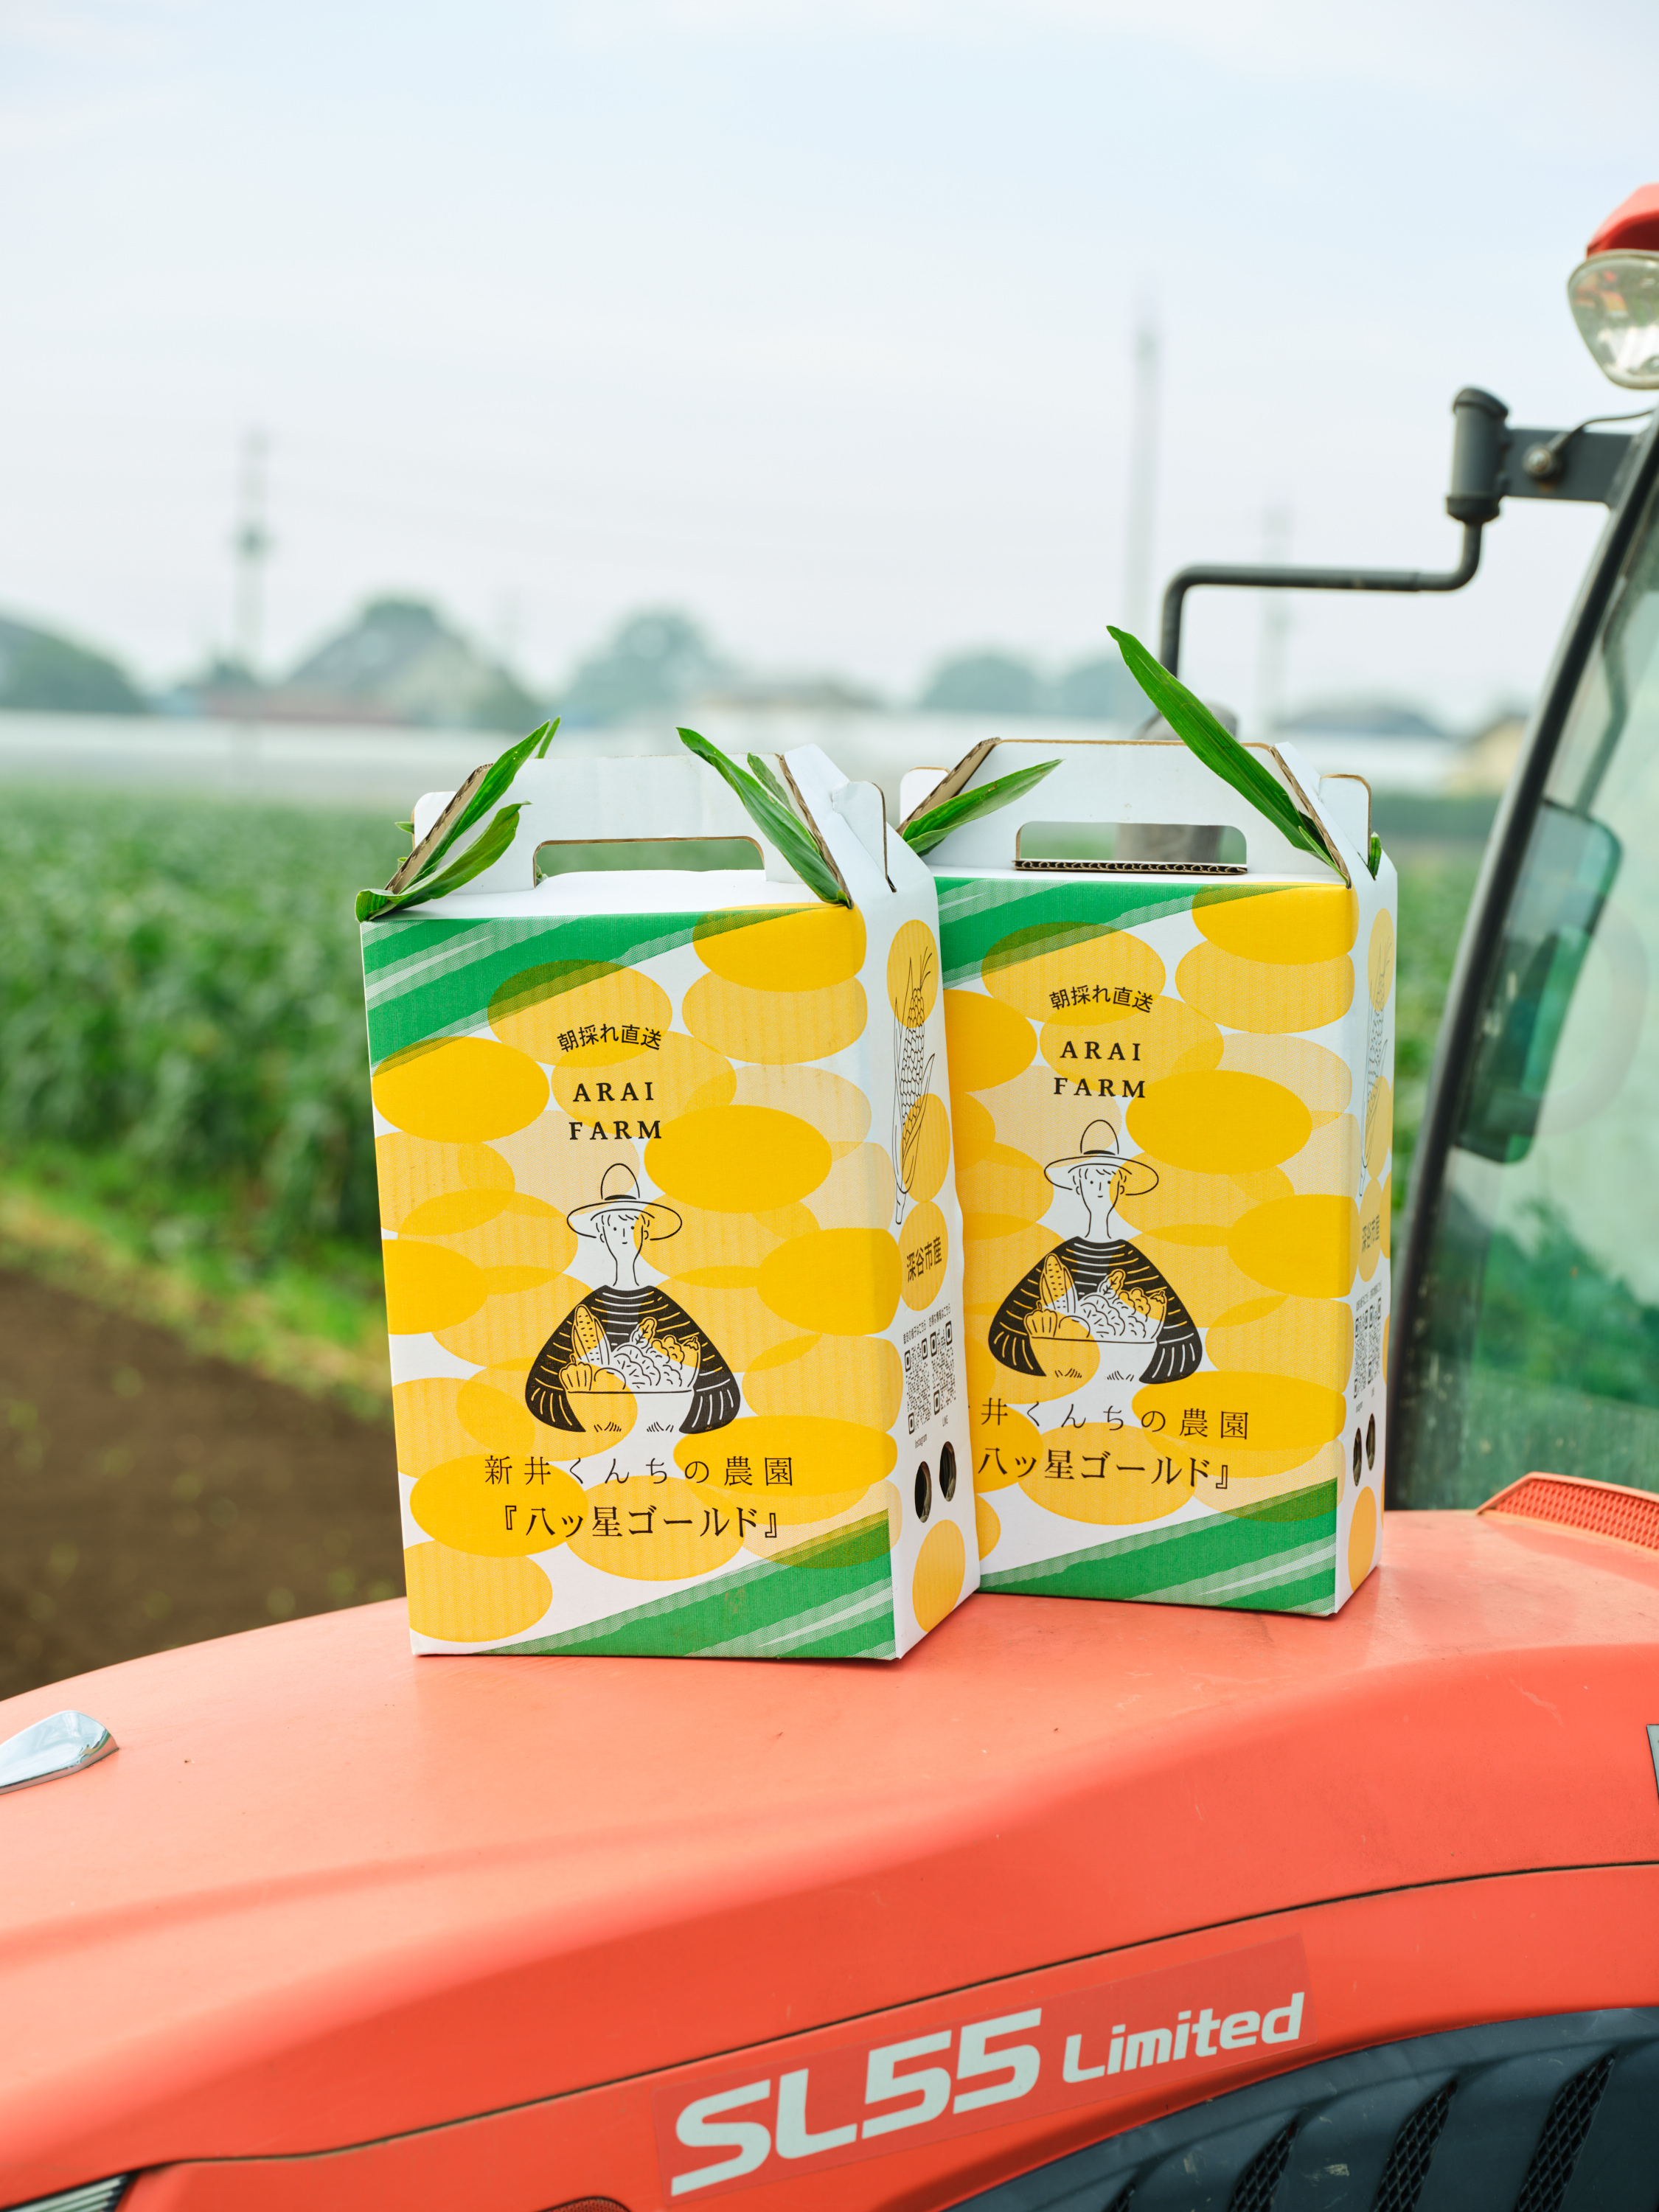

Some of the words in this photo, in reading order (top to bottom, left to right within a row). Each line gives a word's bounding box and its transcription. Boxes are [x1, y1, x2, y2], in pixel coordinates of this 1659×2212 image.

[1048, 984, 1154, 1014] 朝採れ直送
[557, 1023, 662, 1052] 朝採れ直送
[1059, 1040, 1141, 1062] ARAI
[572, 1082, 655, 1103] ARAI
[1053, 1077, 1146, 1099] FARM
[568, 1119, 663, 1141] FARM
[906, 1236, 942, 1283] 深谷市産
[968, 1397, 1249, 1441] 井くんちの農園
[484, 1454, 794, 1488] 新井くんちの農園
[671, 2008, 1042, 2196] SL55
[1062, 1992, 1305, 2083] Limited
